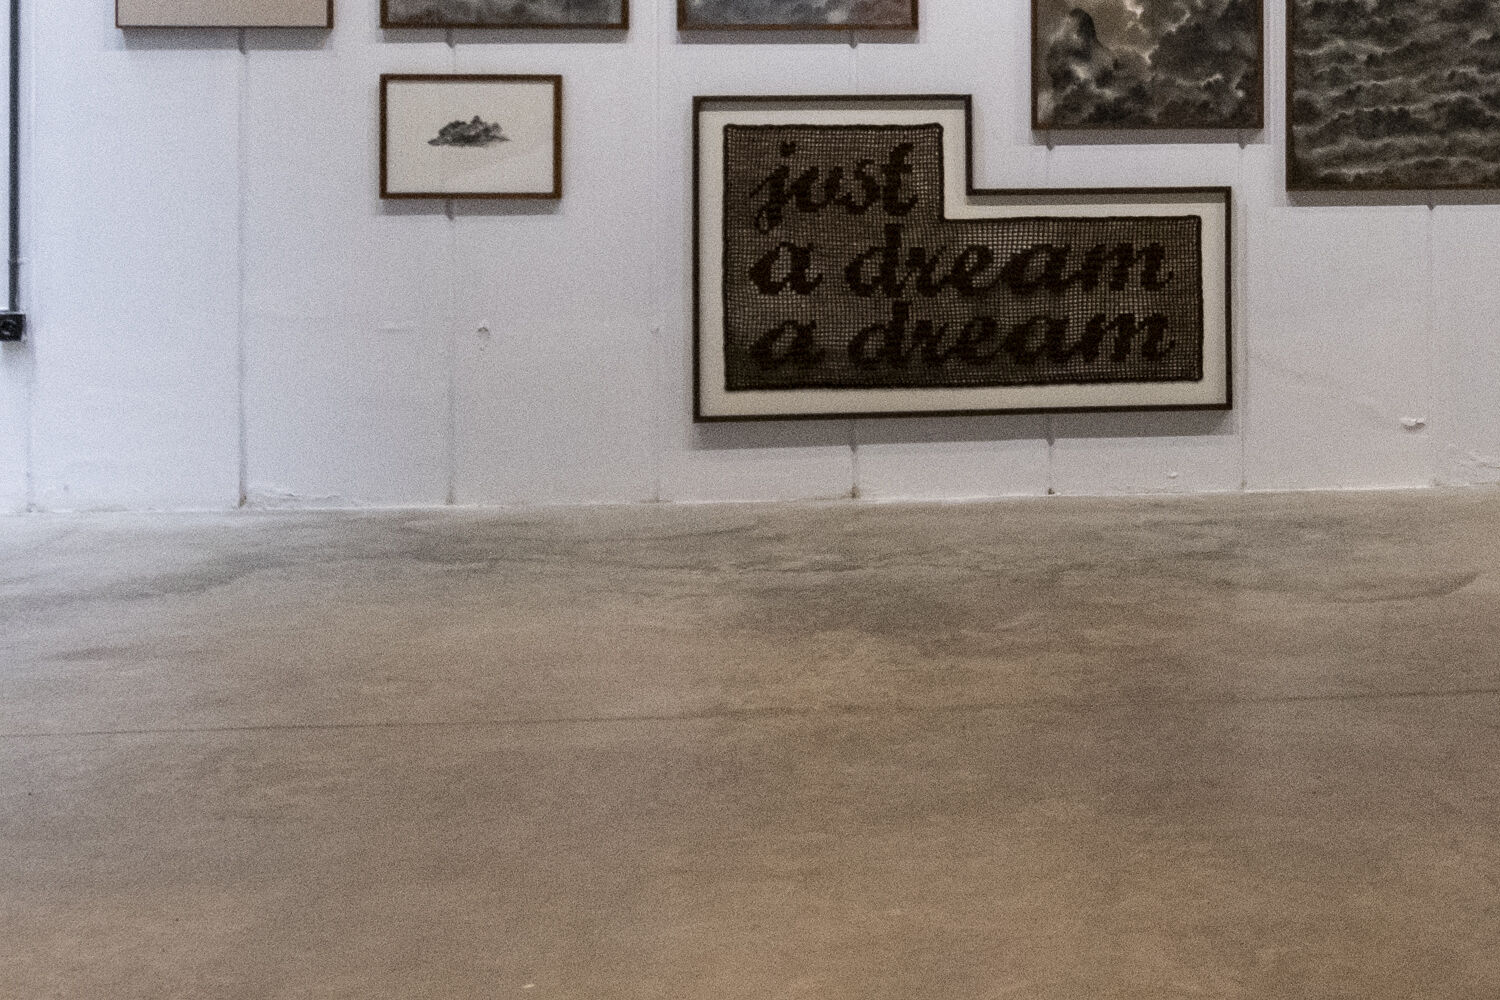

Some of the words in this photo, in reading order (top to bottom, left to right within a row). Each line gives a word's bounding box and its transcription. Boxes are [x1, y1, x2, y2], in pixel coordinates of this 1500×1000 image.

[750, 142, 917, 234] just
[749, 242, 823, 294] a
[845, 223, 1173, 297] dream
[749, 320, 825, 369] a
[848, 299, 1175, 369] dream
